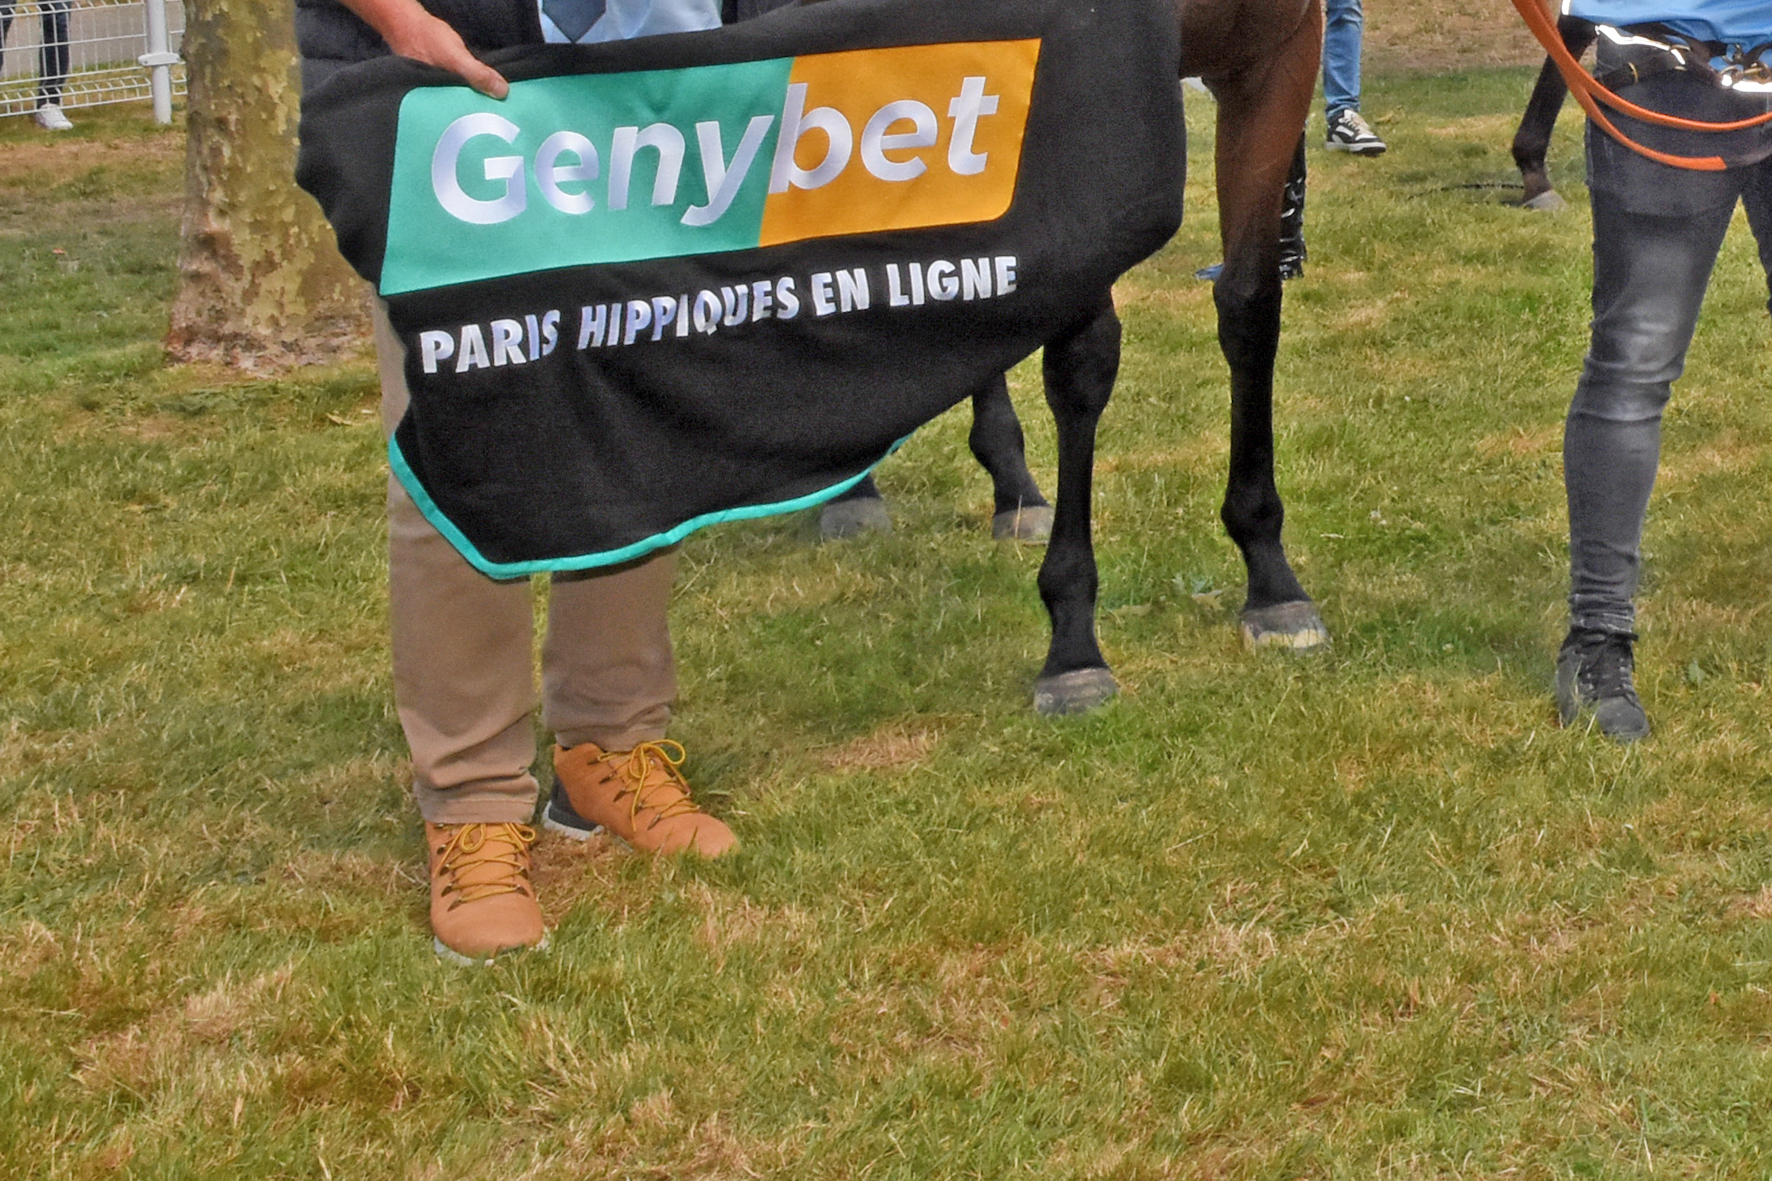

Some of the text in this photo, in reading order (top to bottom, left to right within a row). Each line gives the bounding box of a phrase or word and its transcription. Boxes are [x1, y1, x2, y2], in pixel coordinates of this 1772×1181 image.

[431, 76, 1000, 227] Genybet
[420, 255, 1018, 374] PARIS HIPPIQUES EN LIGNE
